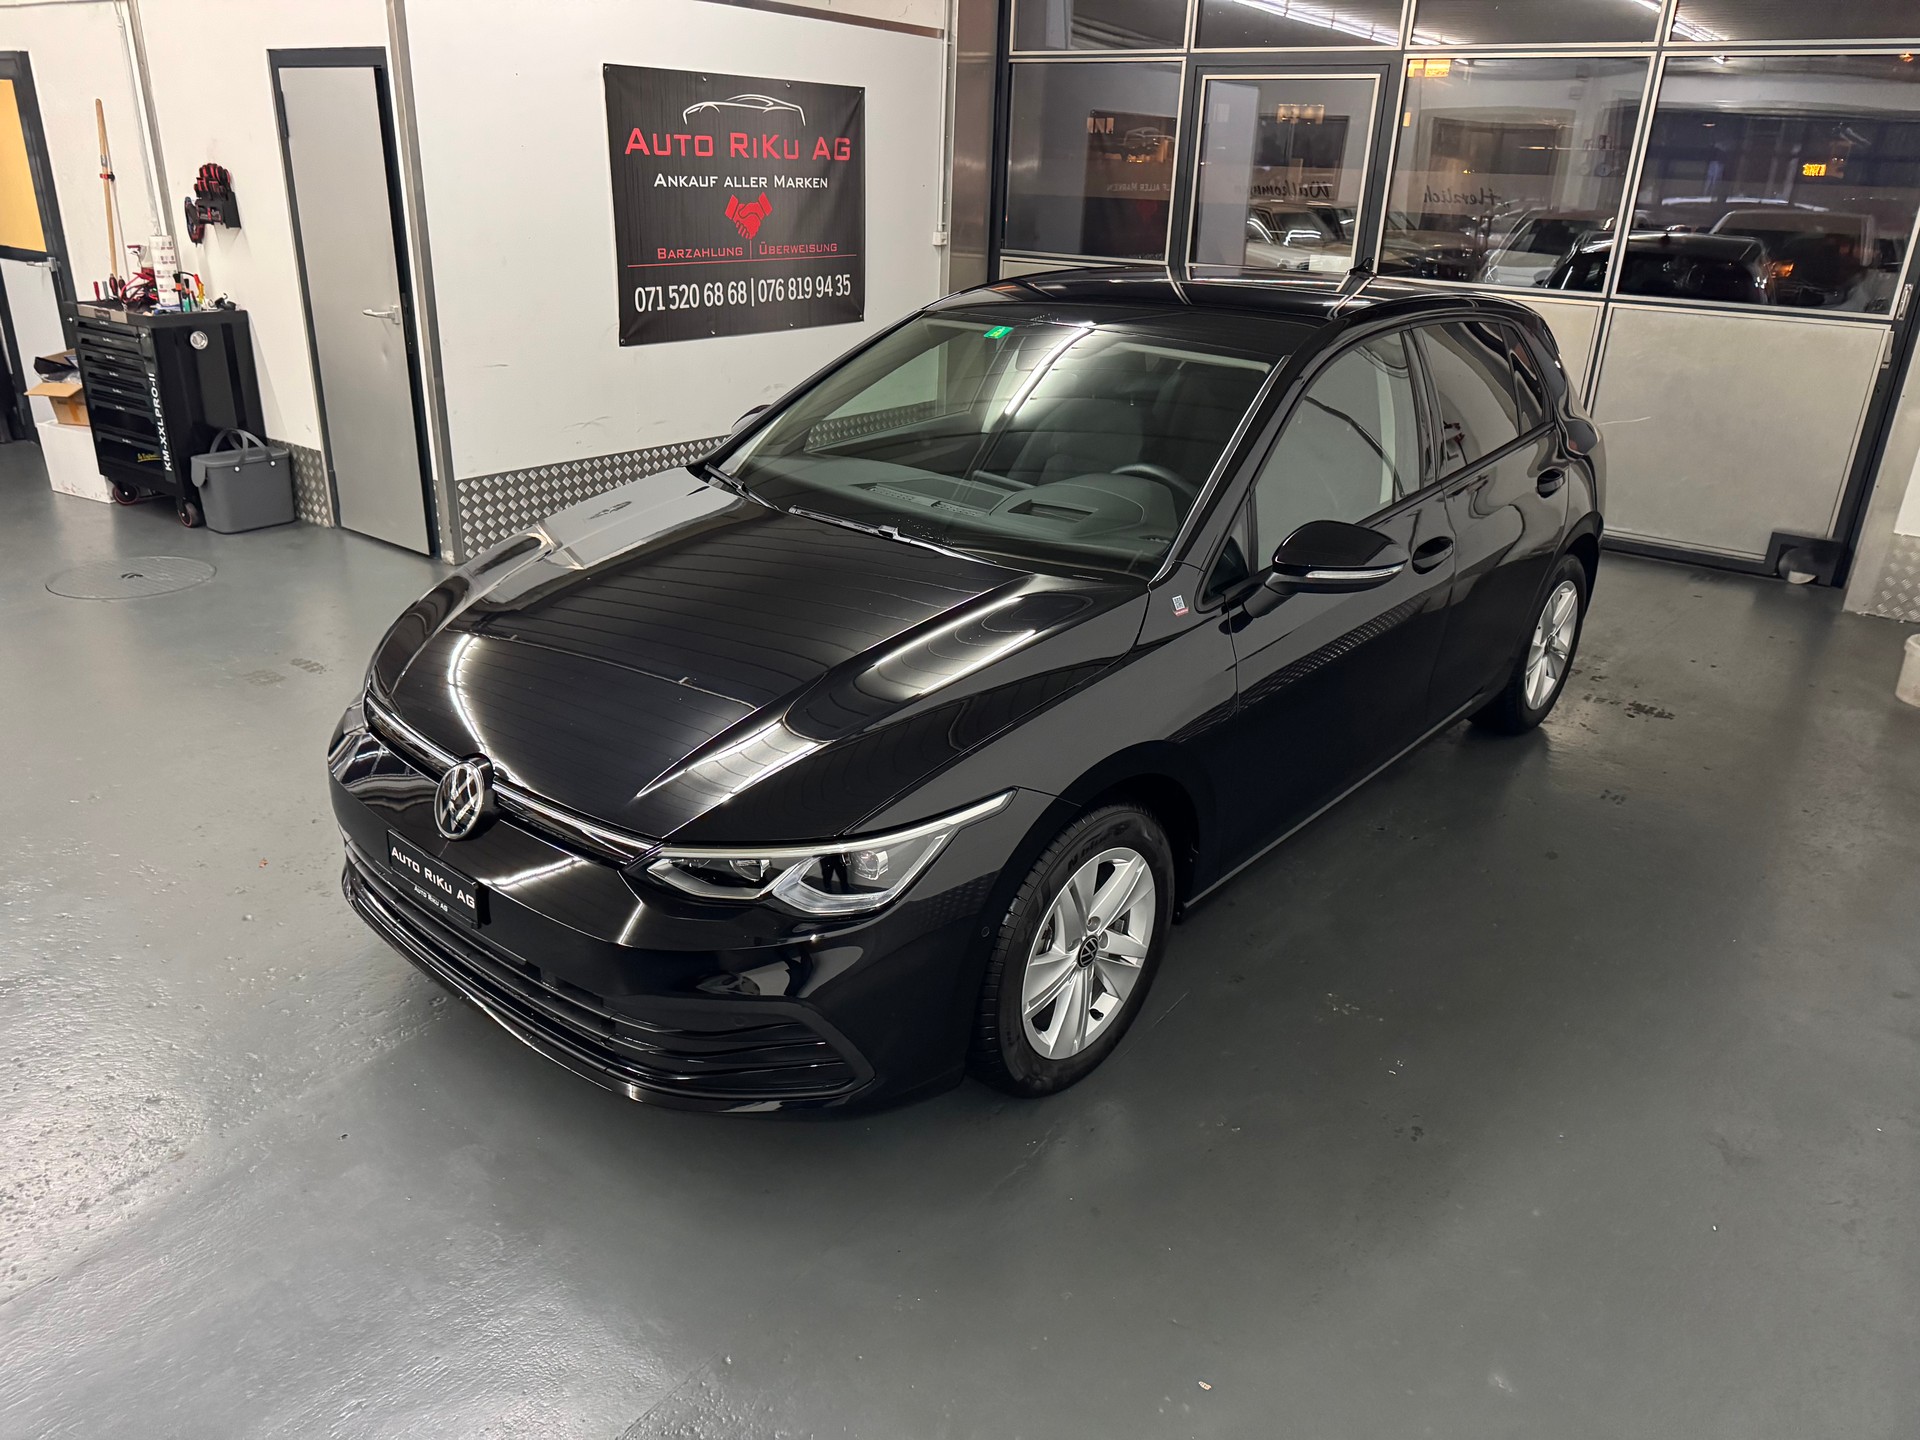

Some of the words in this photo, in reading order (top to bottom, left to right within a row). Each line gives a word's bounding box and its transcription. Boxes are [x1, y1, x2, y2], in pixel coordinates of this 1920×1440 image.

[624, 127, 714, 157] AUTO
[812, 136, 851, 161] AG
[653, 173, 718, 189] ANKAUF
[723, 175, 768, 189] ALLER
[774, 175, 828, 189] MARKEN
[657, 246, 743, 260] BARZAHLUNG
[758, 240, 838, 256] ÜBERWEISUNG
[634, 285, 666, 313] 071
[669, 283, 700, 310] 520
[703, 281, 724, 307] 68
[727, 280, 747, 306] 68
[757, 278, 785, 303] 076
[787, 276, 813, 300] 819
[815, 275, 833, 298] 94
[835, 273, 851, 297] 35
[391, 846, 420, 874] AUTO
[456, 889, 476, 909] AG
